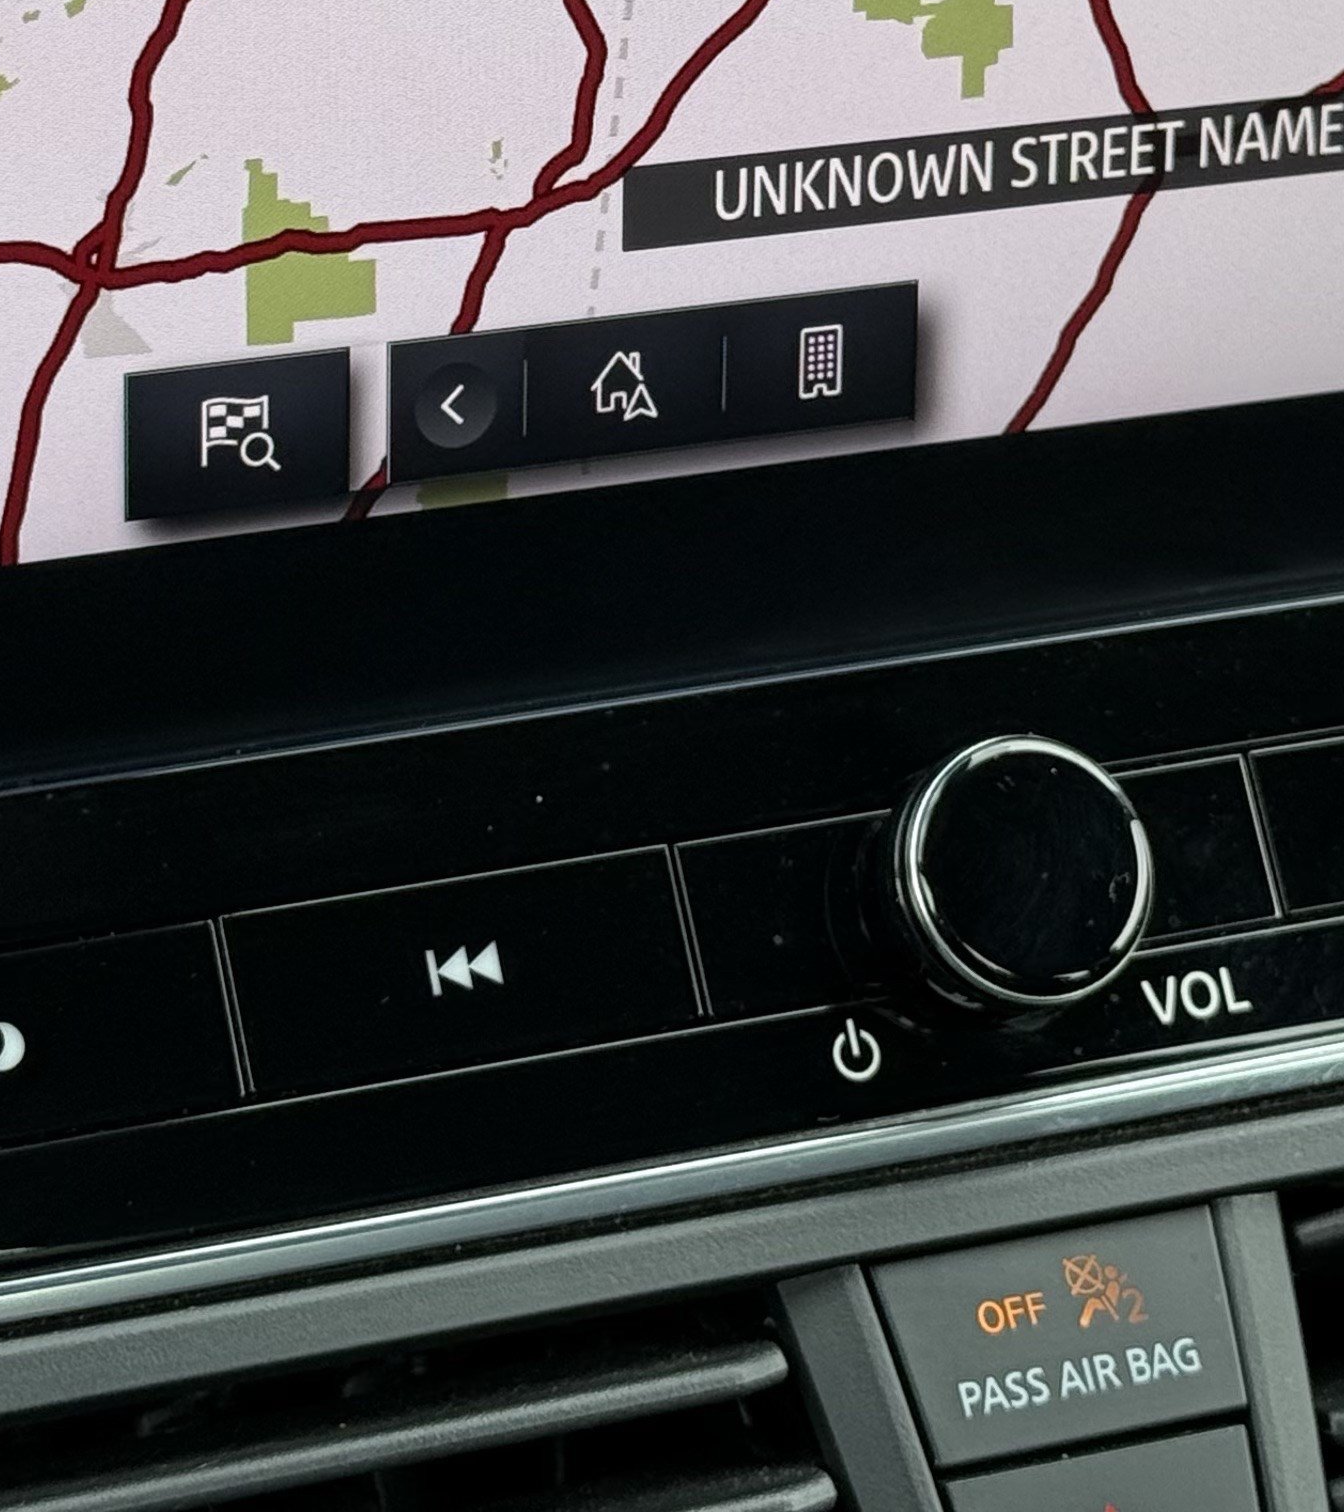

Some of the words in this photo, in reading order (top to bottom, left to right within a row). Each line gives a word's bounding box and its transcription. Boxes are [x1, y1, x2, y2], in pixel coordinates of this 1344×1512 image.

[713, 140, 994, 222] UNKNOWN
[1009, 120, 1185, 190] STREET
[1140, 966, 1253, 1026] VOL
[975, 1291, 1048, 1335] OFF
[958, 1365, 1052, 1419] PASS
[1059, 1350, 1124, 1400] AIR
[1126, 1336, 1203, 1384] BAG
